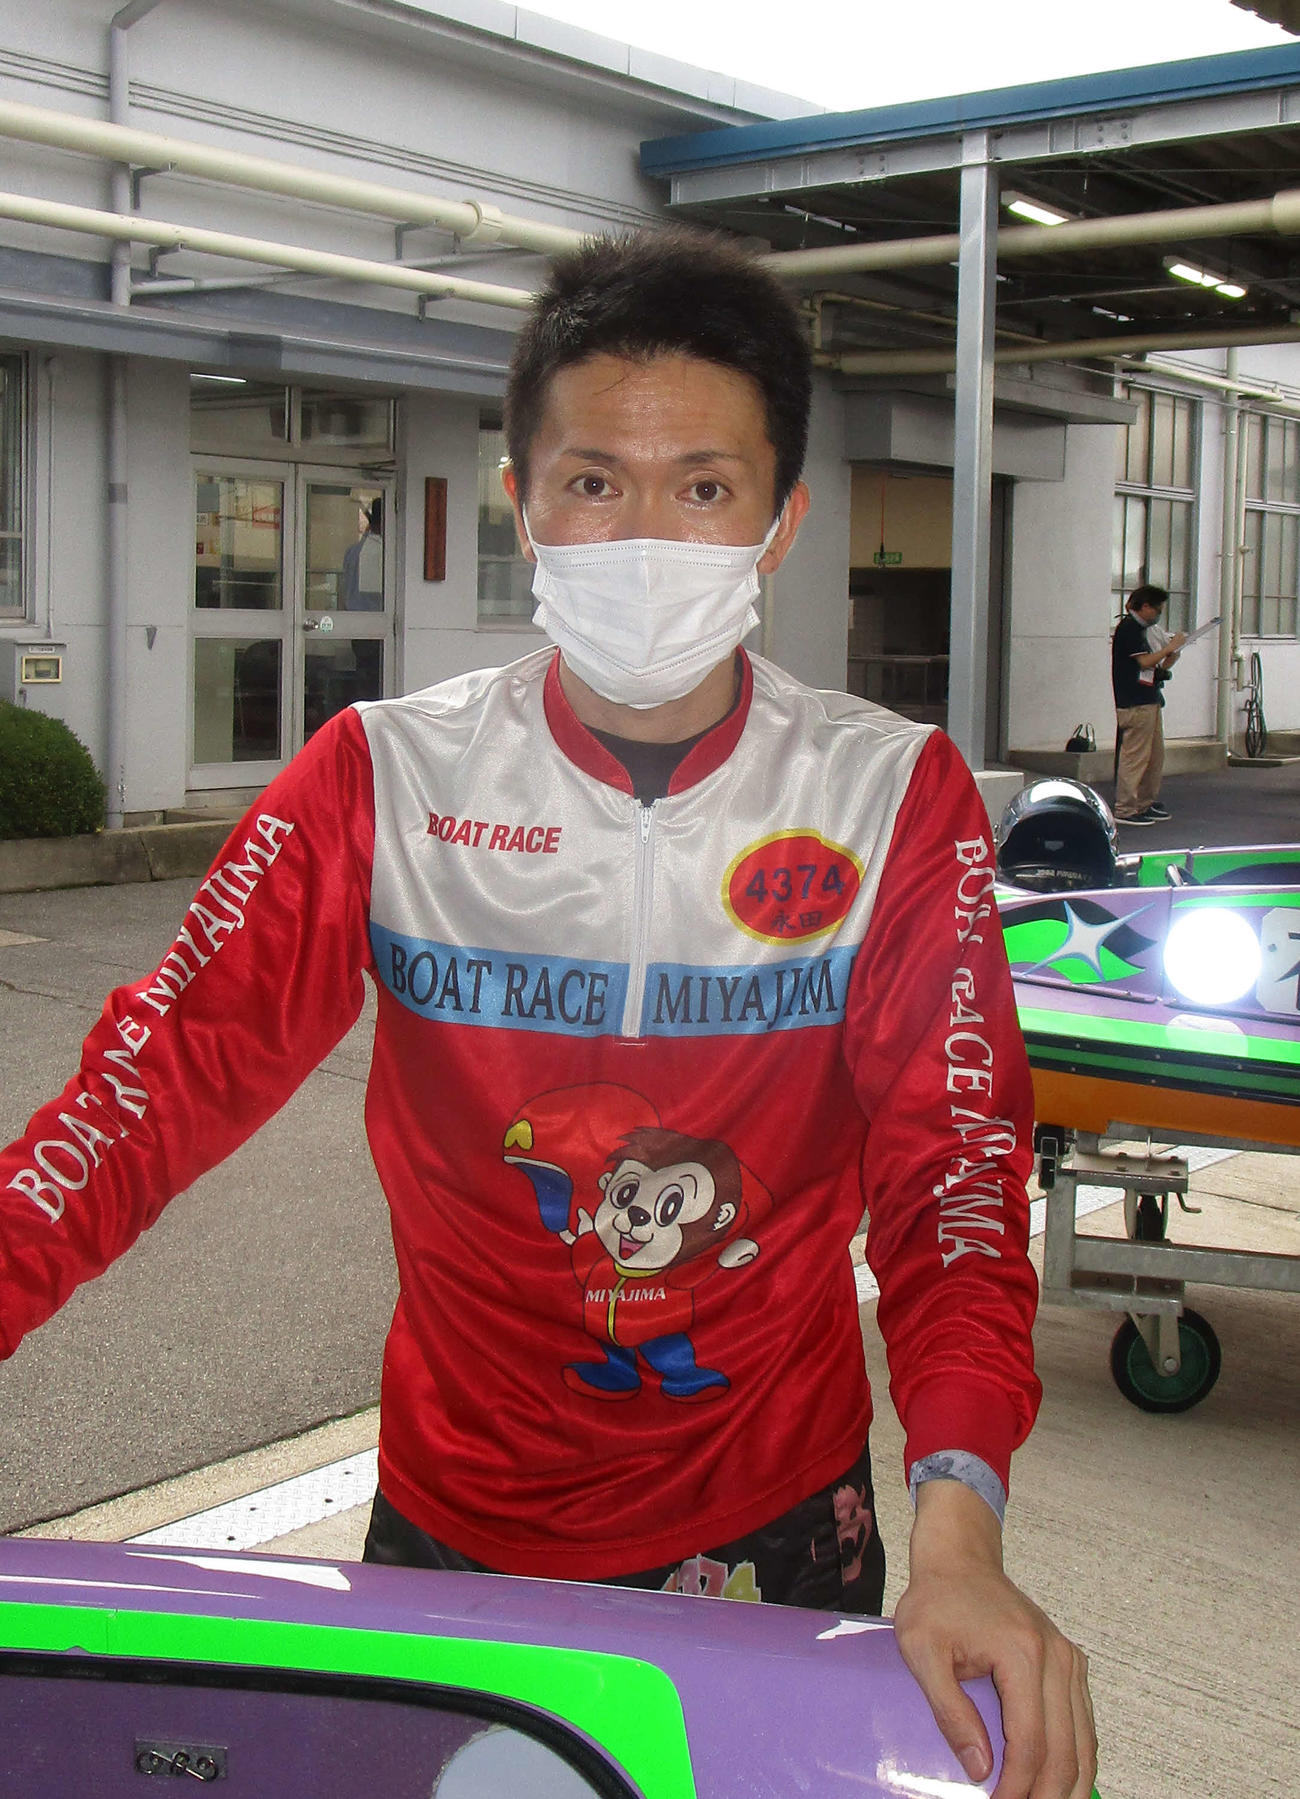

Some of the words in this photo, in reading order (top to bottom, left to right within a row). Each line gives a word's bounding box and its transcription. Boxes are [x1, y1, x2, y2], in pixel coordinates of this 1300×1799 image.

[426, 812, 488, 848] BOAT
[488, 824, 562, 853] RACE
[745, 864, 845, 903] 4374
[135, 813, 295, 1017] MIYAJIMA
[770, 909, 823, 933] 永田
[390, 942, 493, 1013] BOAT
[500, 963, 609, 1026] RACE
[652, 957, 855, 1031] MIYAJIM
[585, 1287, 666, 1304] MIYAJIMA
